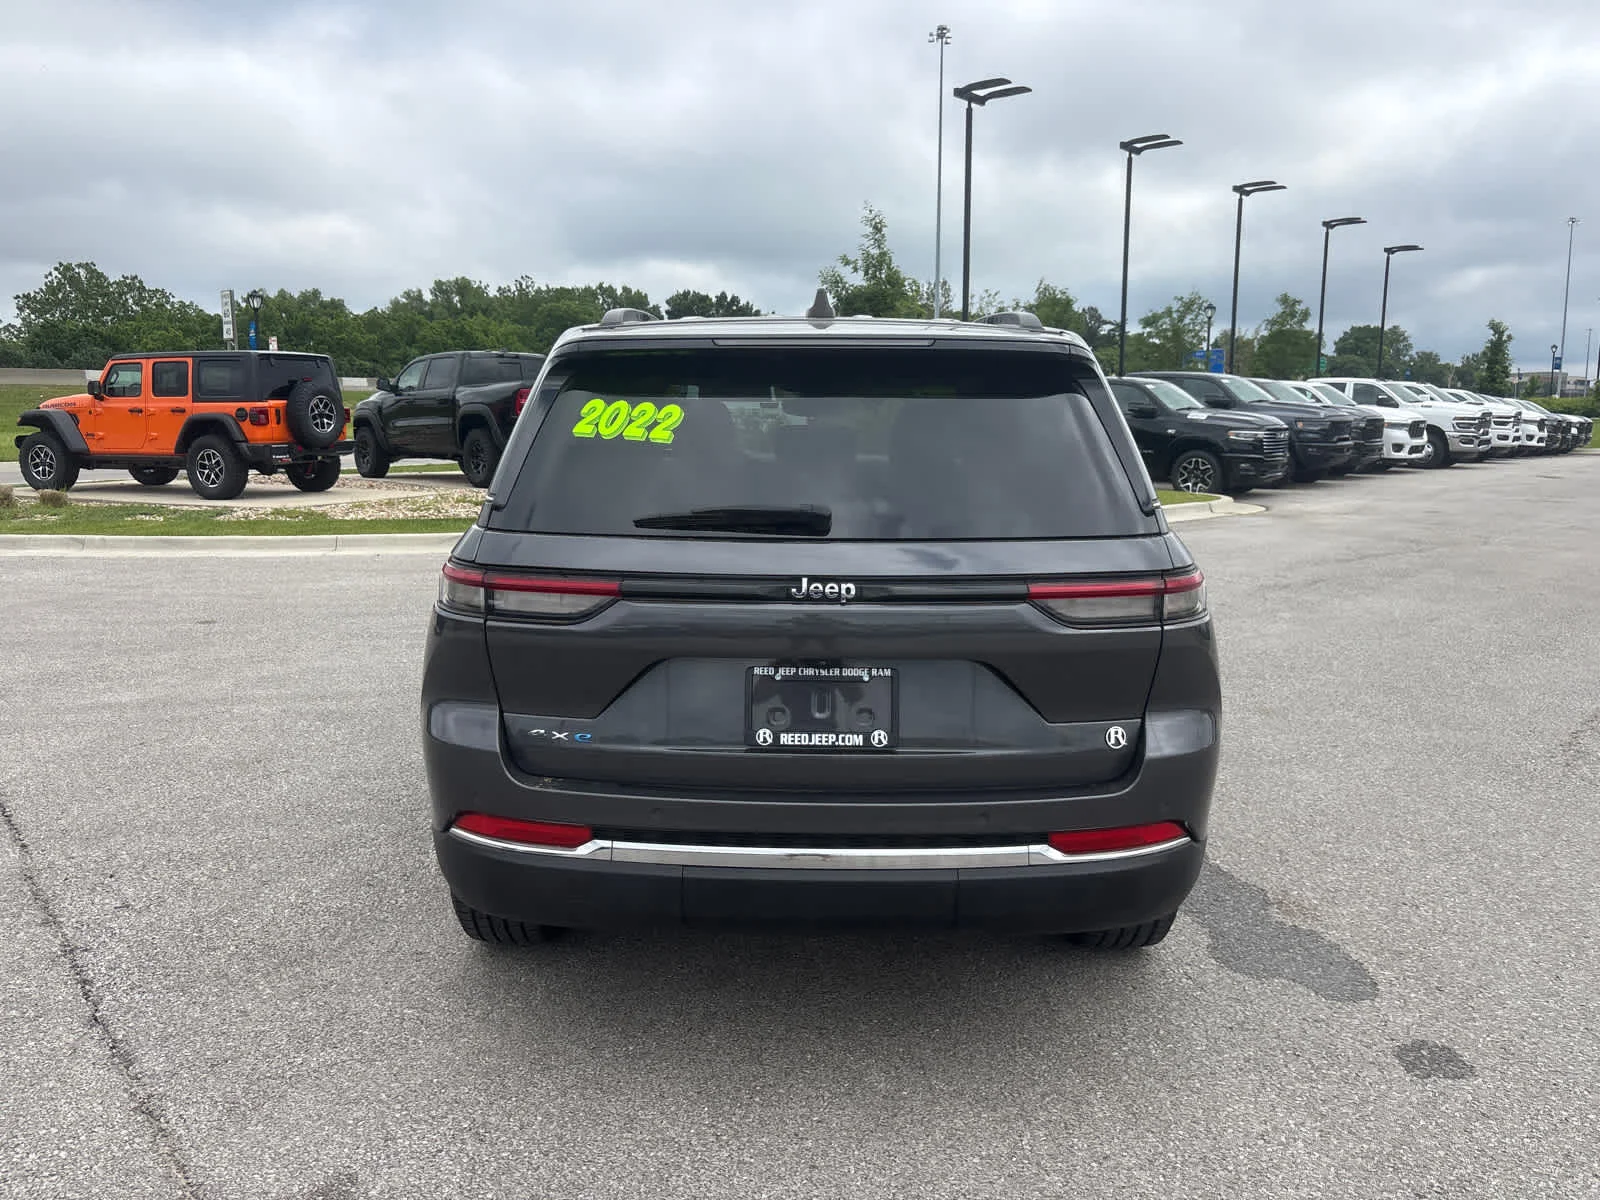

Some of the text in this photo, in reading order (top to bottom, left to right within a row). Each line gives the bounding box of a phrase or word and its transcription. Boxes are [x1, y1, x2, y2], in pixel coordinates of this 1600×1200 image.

[572, 398, 685, 444] 2022
[791, 577, 856, 603] Jeep
[754, 667, 892, 677] REED JEEP CHRYSLER DODGE RAM
[780, 733, 864, 747] REEDJEEP.COM
